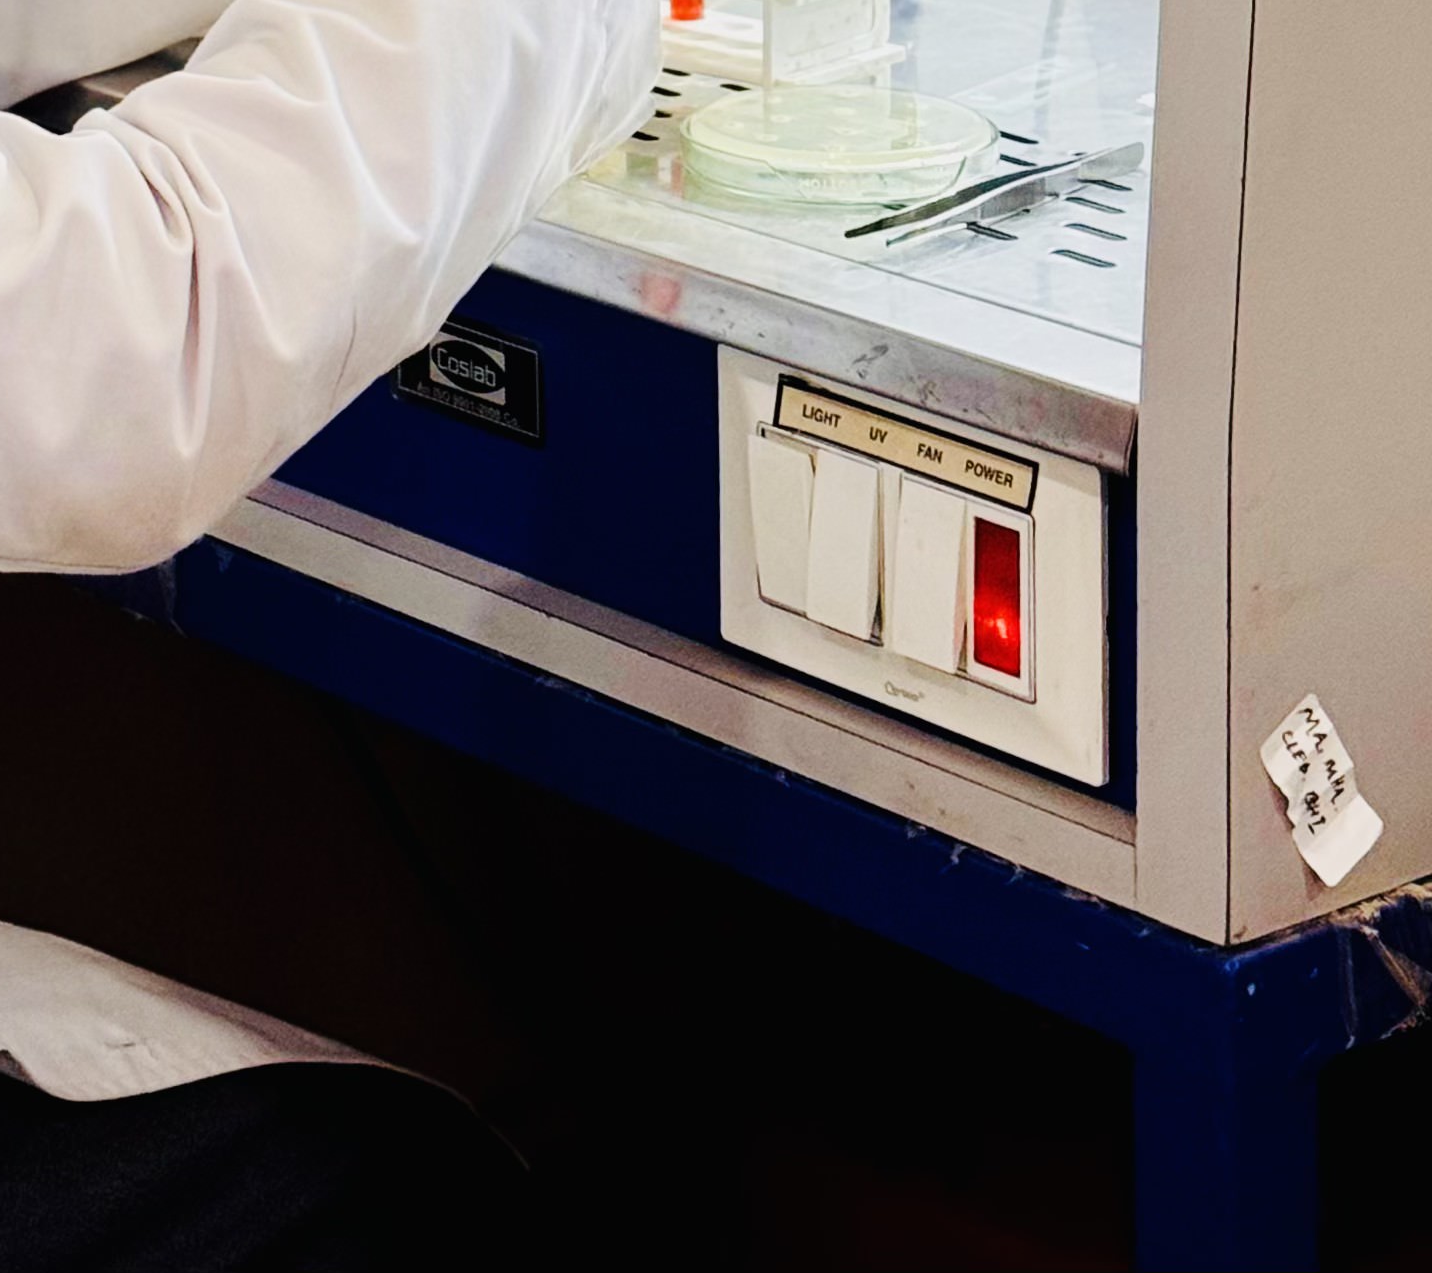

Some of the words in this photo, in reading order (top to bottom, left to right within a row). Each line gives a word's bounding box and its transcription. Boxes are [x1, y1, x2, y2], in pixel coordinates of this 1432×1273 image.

[436, 347, 496, 387] Coslab
[802, 403, 842, 428] LIGHT
[869, 426, 888, 444] UV
[917, 443, 944, 464] FAN
[965, 459, 1014, 488] POWER
